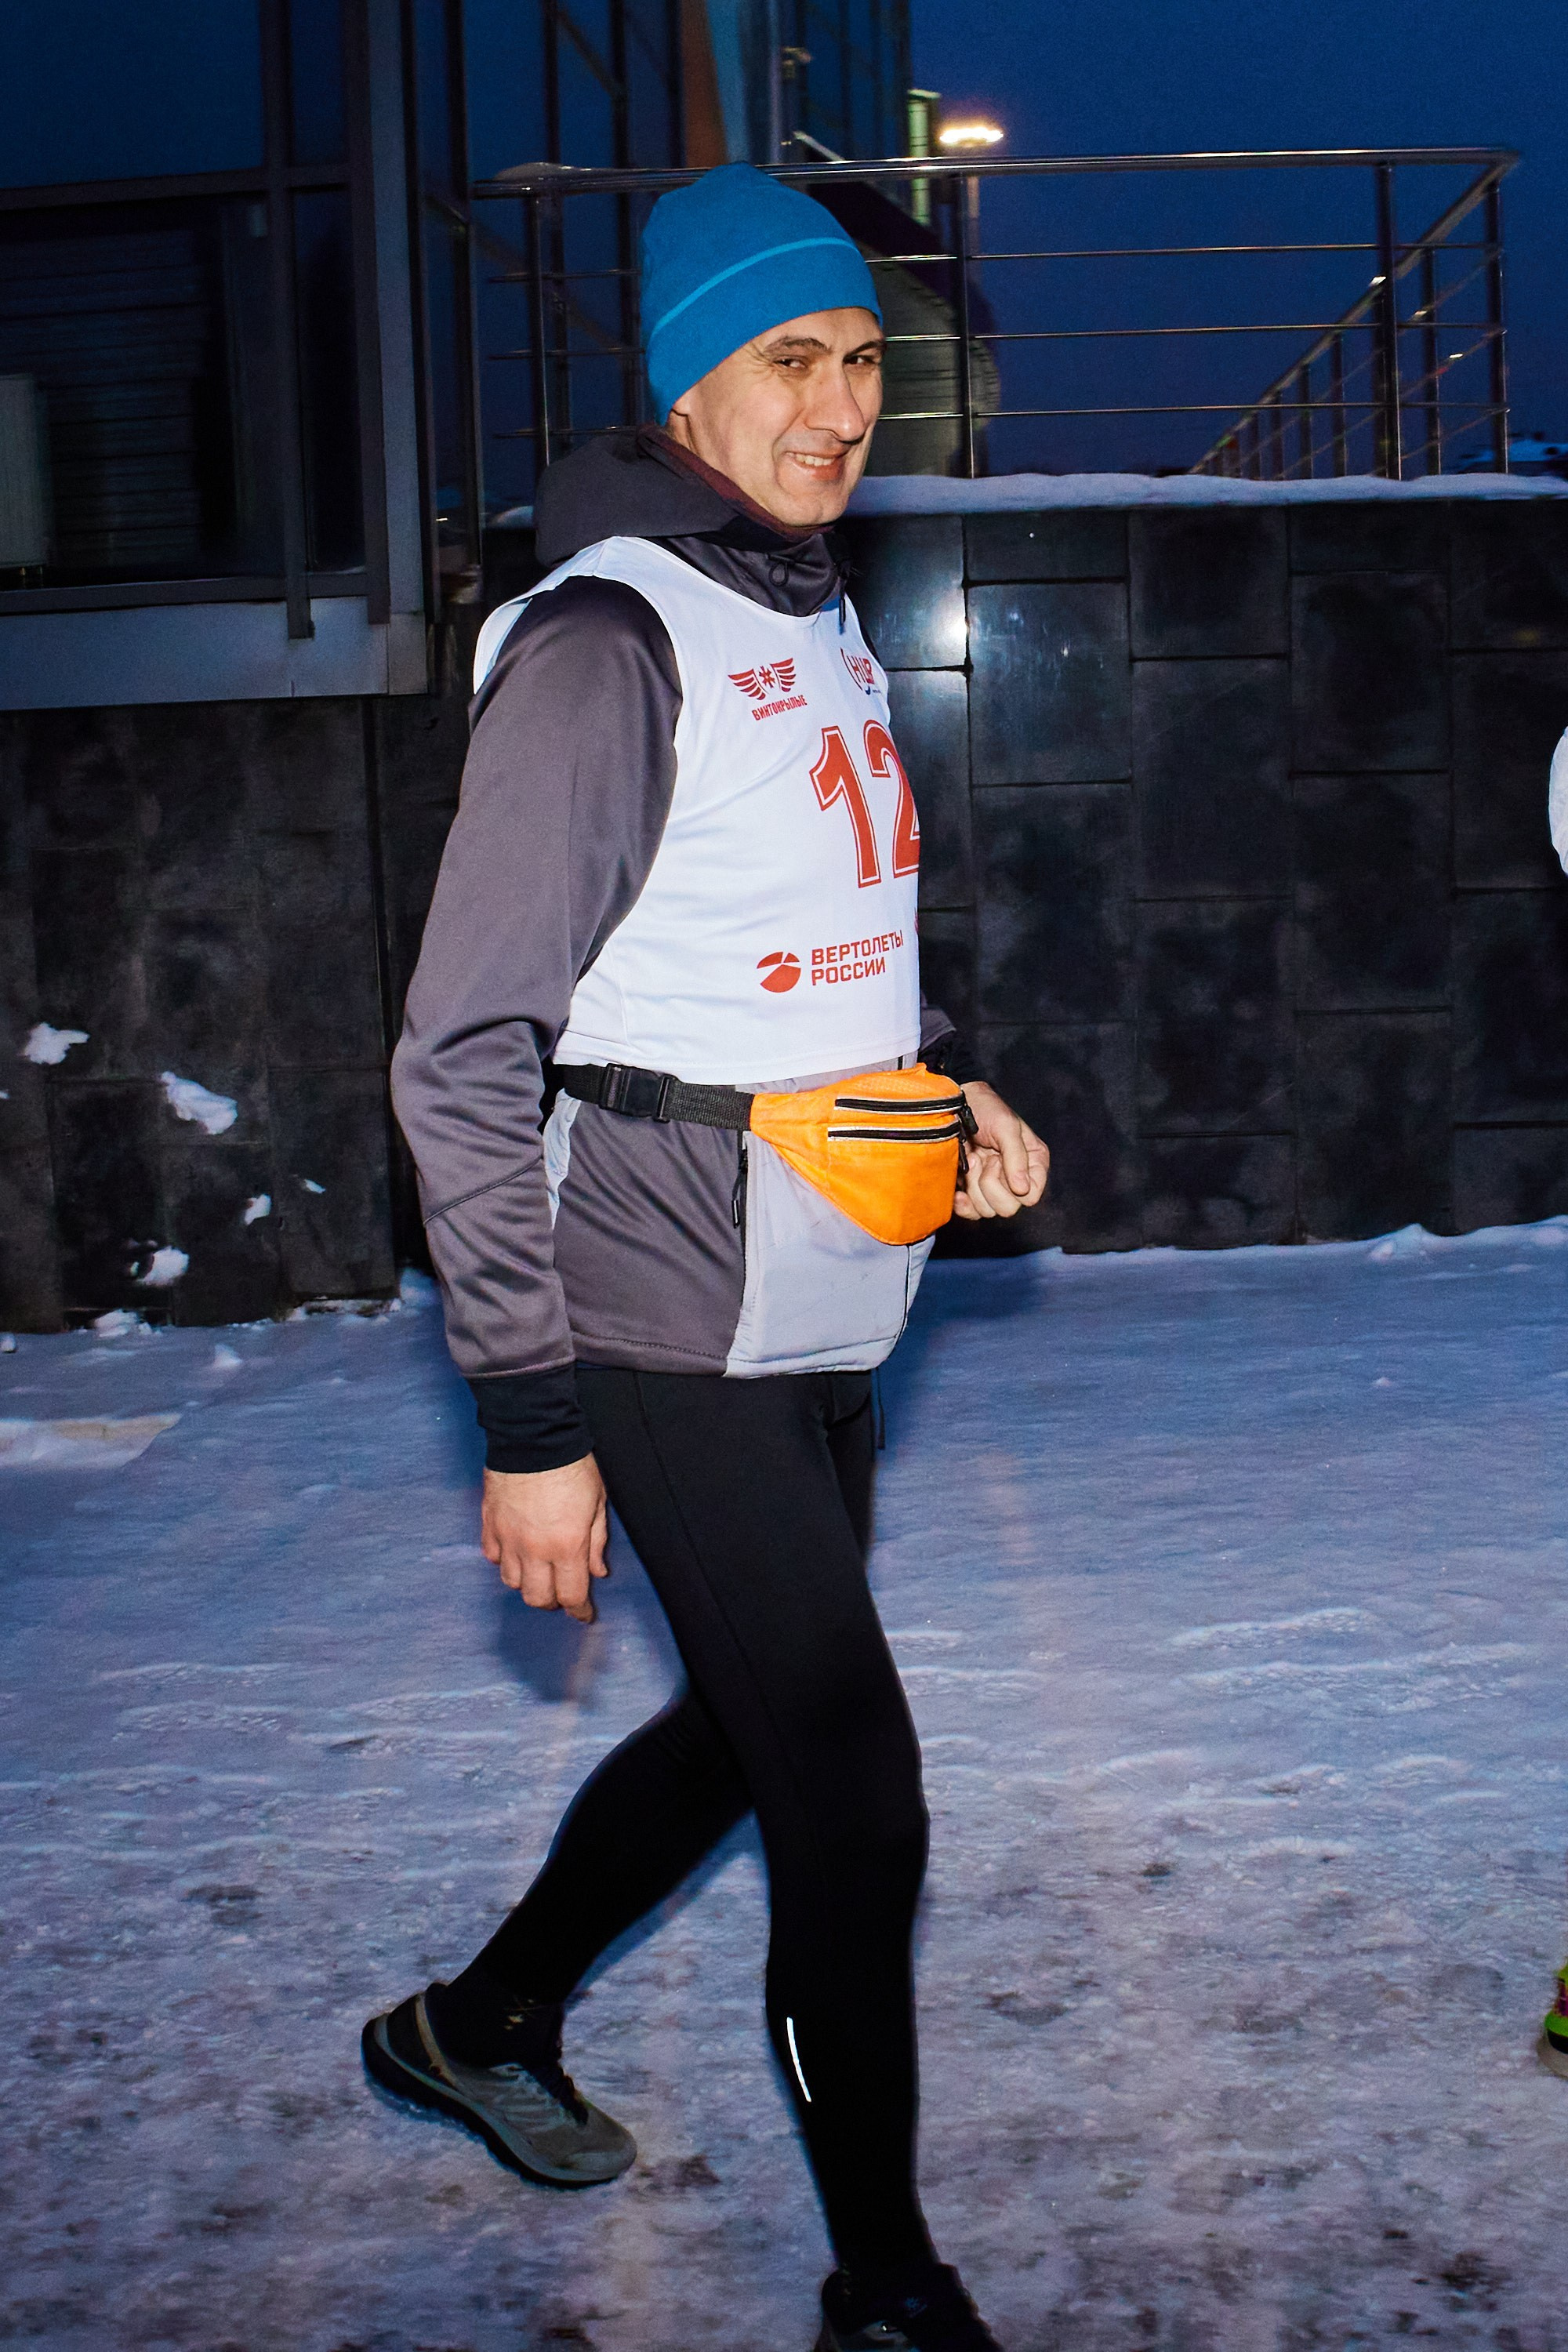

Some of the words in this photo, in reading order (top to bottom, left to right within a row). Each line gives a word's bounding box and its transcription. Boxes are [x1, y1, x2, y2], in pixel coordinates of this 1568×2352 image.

[752, 695, 808, 720] ВИНТОКРЫЛЫЕ
[809, 719, 920, 889] 12
[811, 929, 904, 966] ВЕРТОЛЕТЫ
[811, 956, 886, 985] РОССИИ
